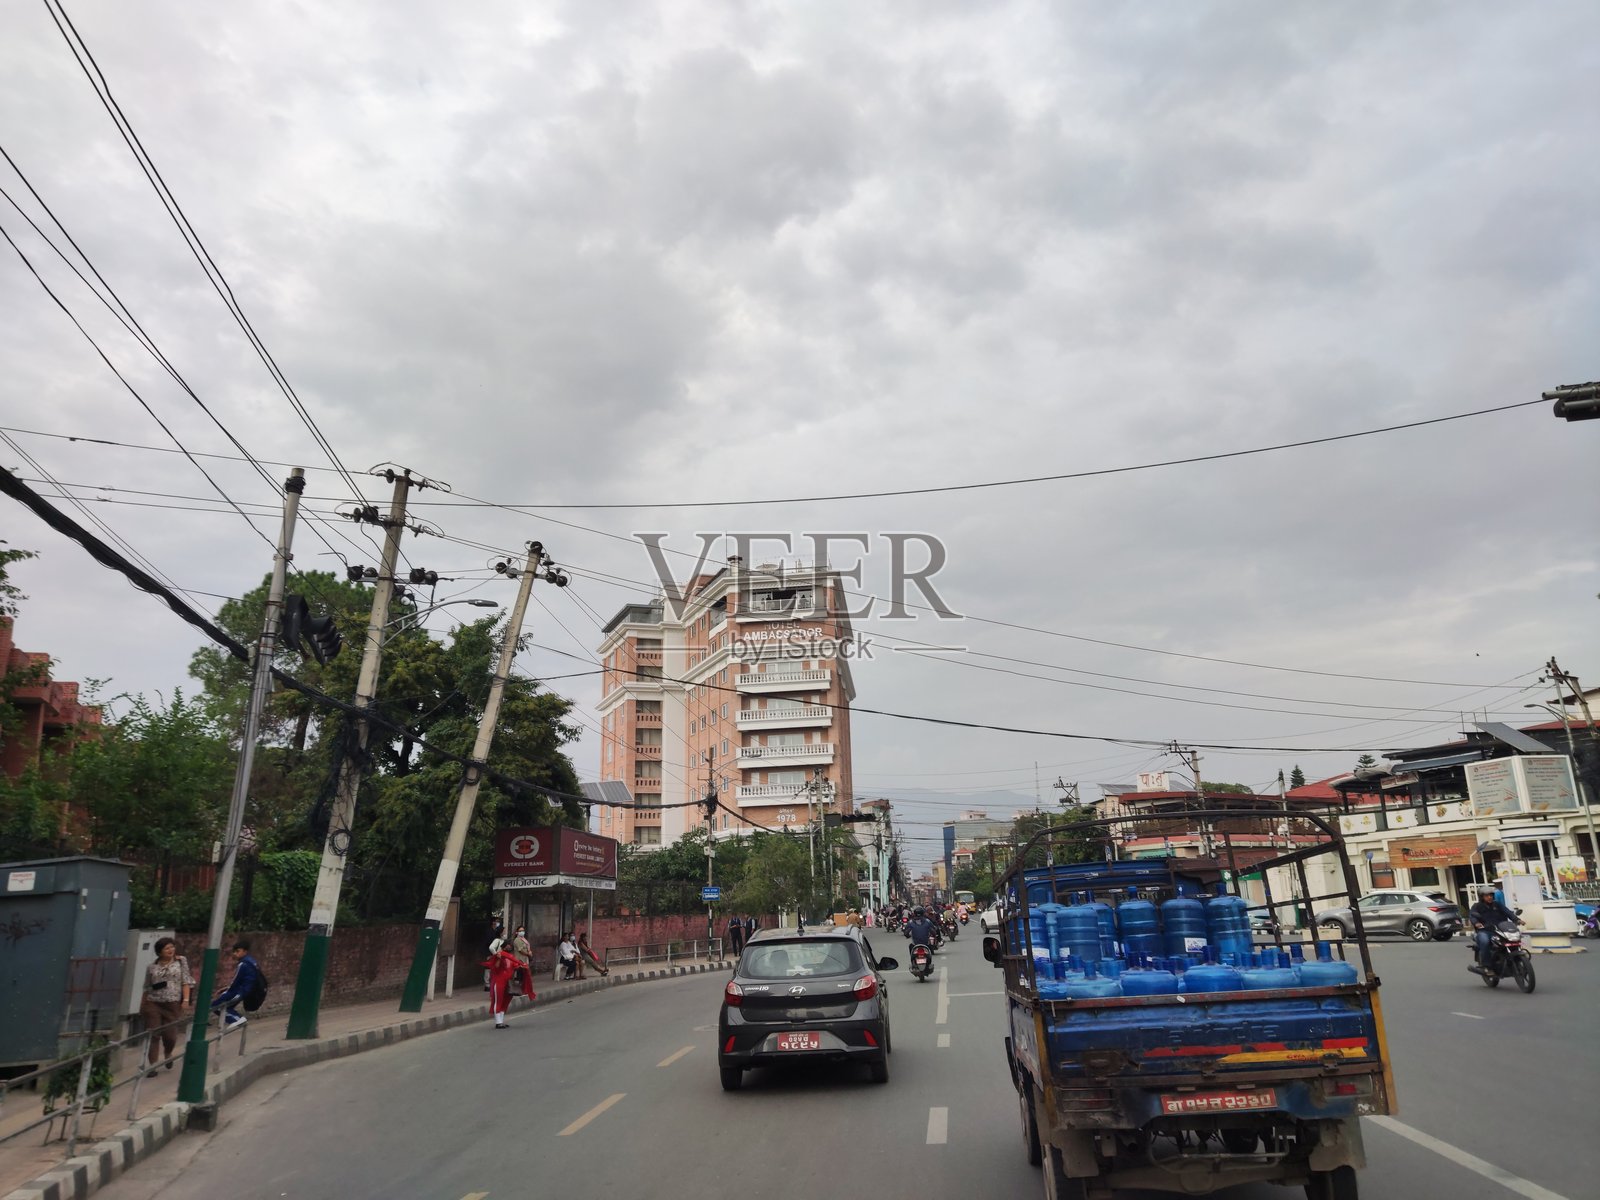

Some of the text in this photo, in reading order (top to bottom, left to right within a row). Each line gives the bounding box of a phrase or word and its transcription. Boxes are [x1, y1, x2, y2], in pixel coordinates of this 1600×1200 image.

[764, 622, 800, 630] HOTEL
[743, 628, 823, 641] AMBASSADOR
[776, 814, 797, 823] 1978
[1167, 1100, 1183, 1112] बा
